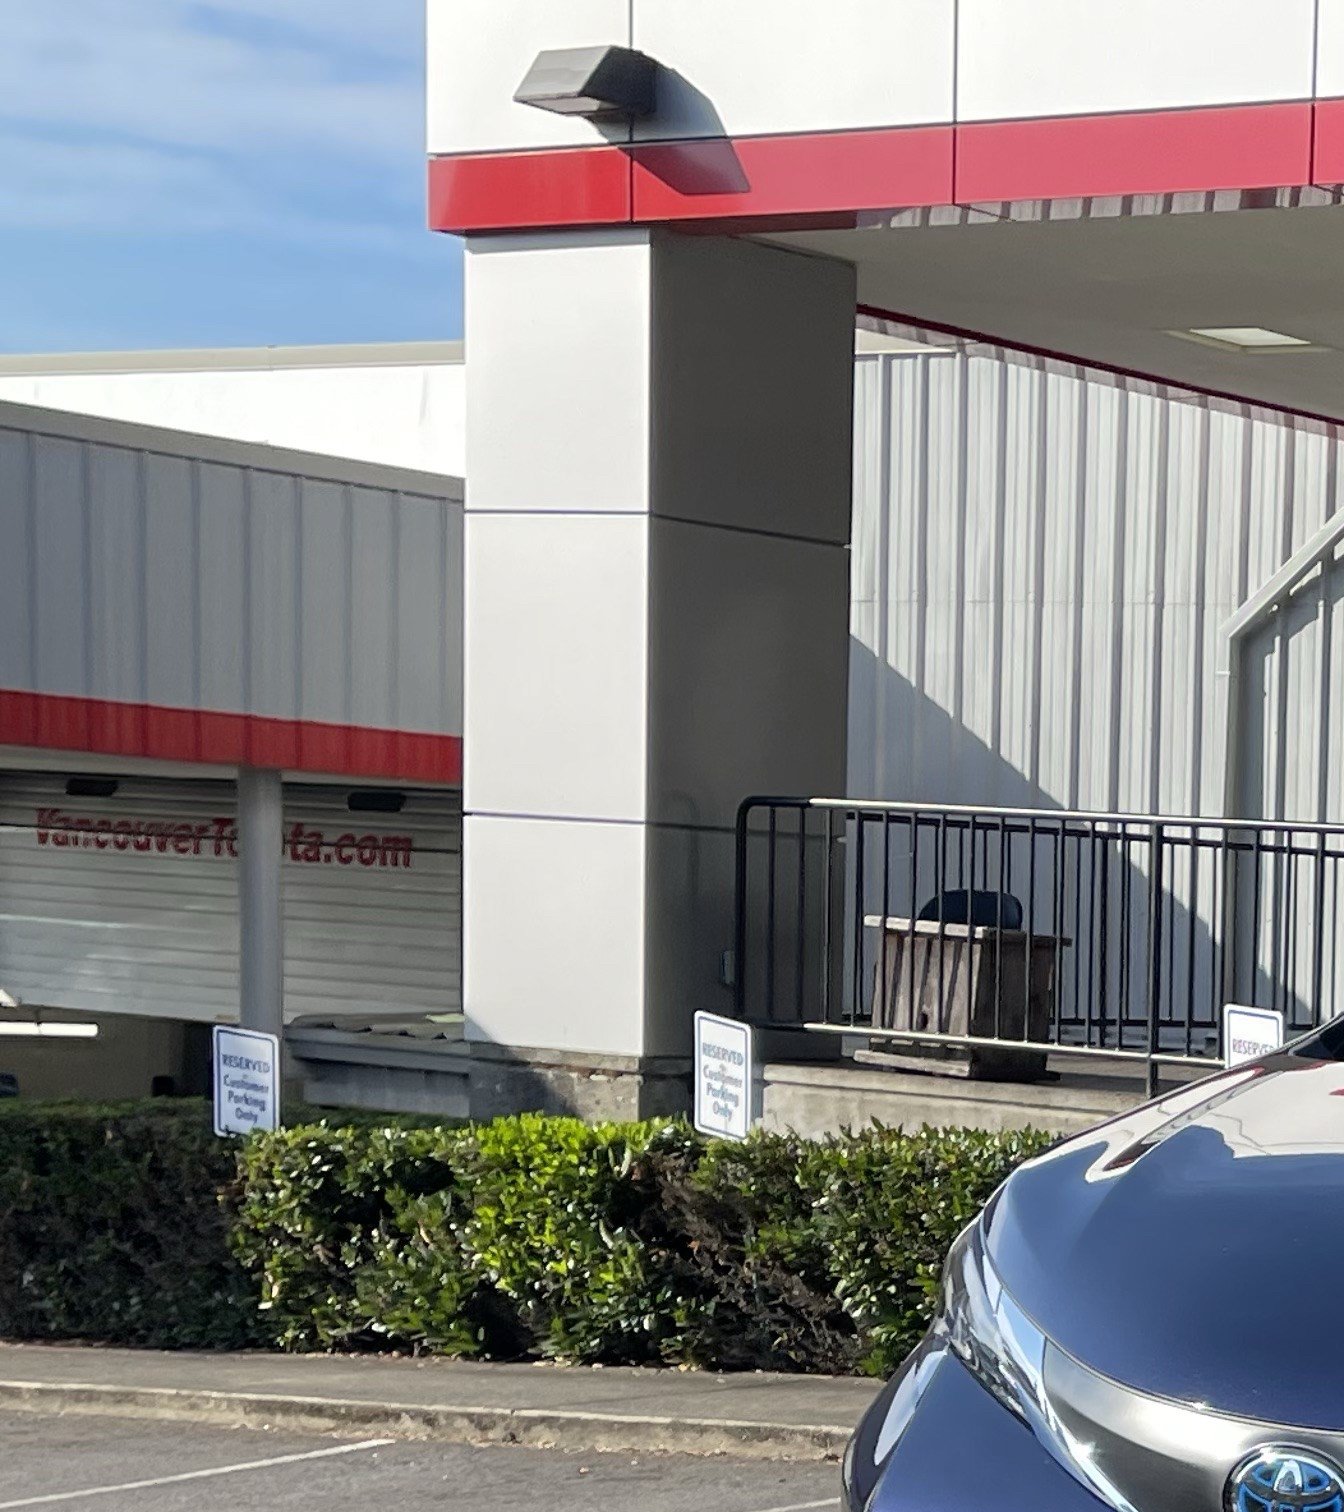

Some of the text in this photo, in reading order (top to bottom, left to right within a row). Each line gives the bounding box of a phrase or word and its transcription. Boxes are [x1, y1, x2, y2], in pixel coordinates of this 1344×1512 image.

[36, 807, 413, 868] VancouverTta.com
[702, 1042, 744, 1067] RESERVED
[1232, 1038, 1275, 1056] RESERVE
[221, 1053, 271, 1074] RESERVED
[228, 1090, 267, 1112] Parking
[706, 1081, 740, 1108] Parking
